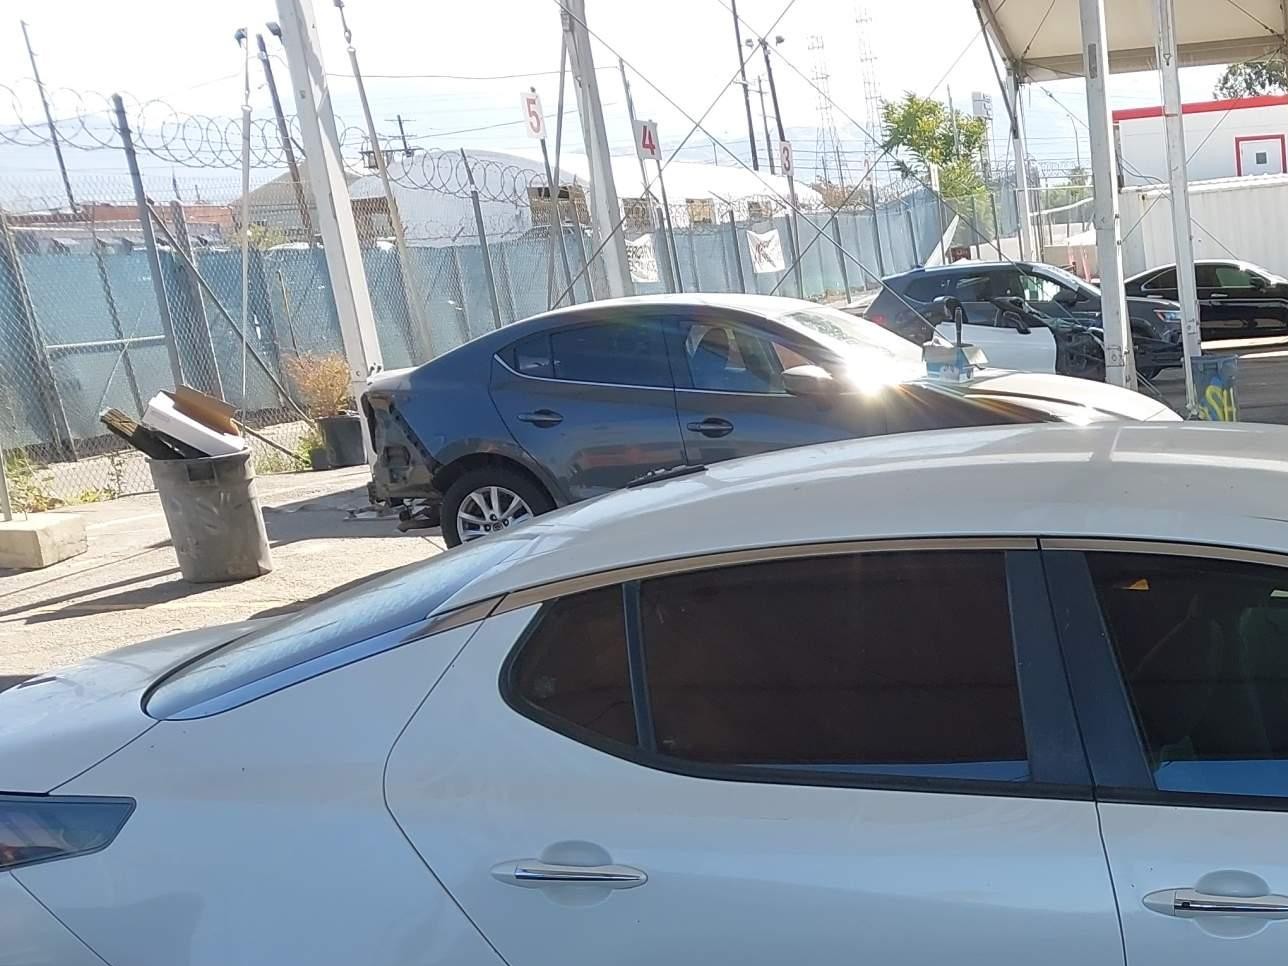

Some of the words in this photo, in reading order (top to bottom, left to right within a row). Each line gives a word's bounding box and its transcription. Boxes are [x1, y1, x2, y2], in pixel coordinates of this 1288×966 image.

[527, 98, 541, 134] 5
[642, 125, 656, 156] 4
[782, 146, 791, 171] 3
